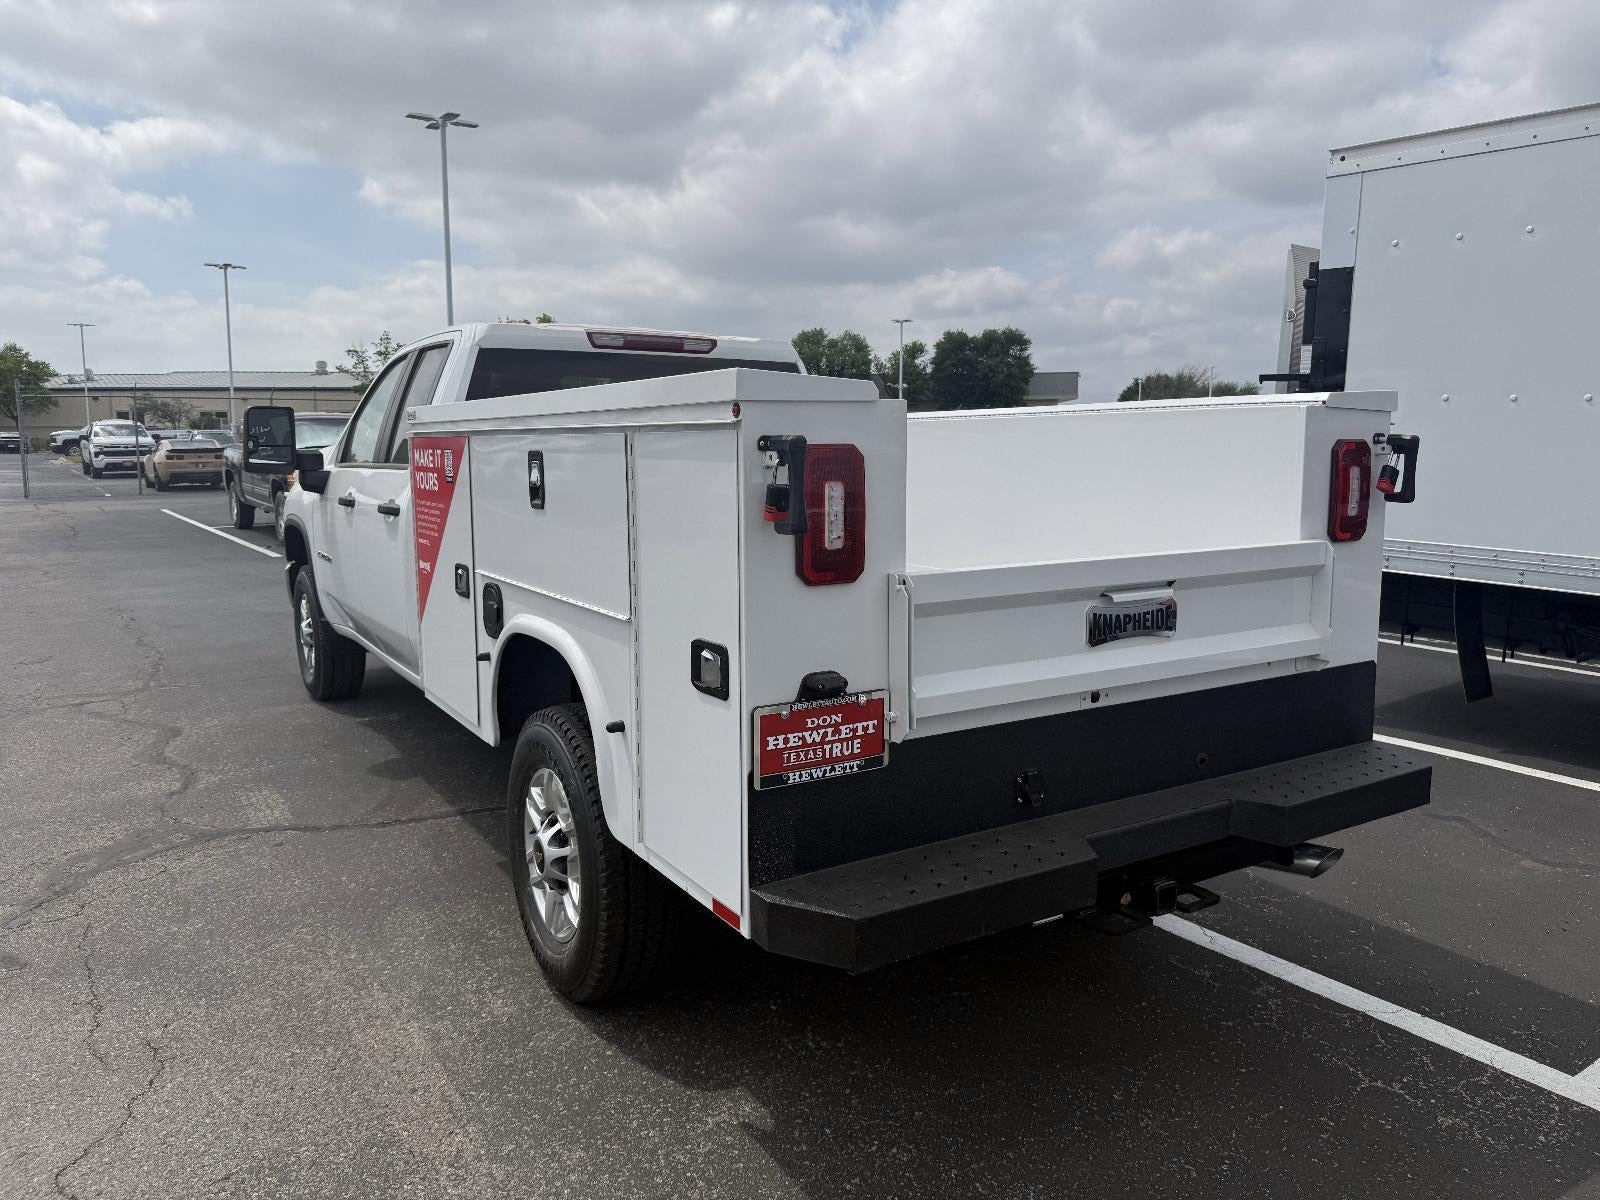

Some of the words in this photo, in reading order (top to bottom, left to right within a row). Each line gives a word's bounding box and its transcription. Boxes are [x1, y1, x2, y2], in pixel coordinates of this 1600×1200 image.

[414, 448, 433, 468] MAKE
[434, 449, 441, 469] IT
[415, 471, 439, 491] YOURS
[1092, 604, 1175, 641] KNAPHEIDE
[805, 713, 843, 728] DON
[766, 720, 878, 750] HEWLETT
[787, 760, 861, 784] HEWLETT
